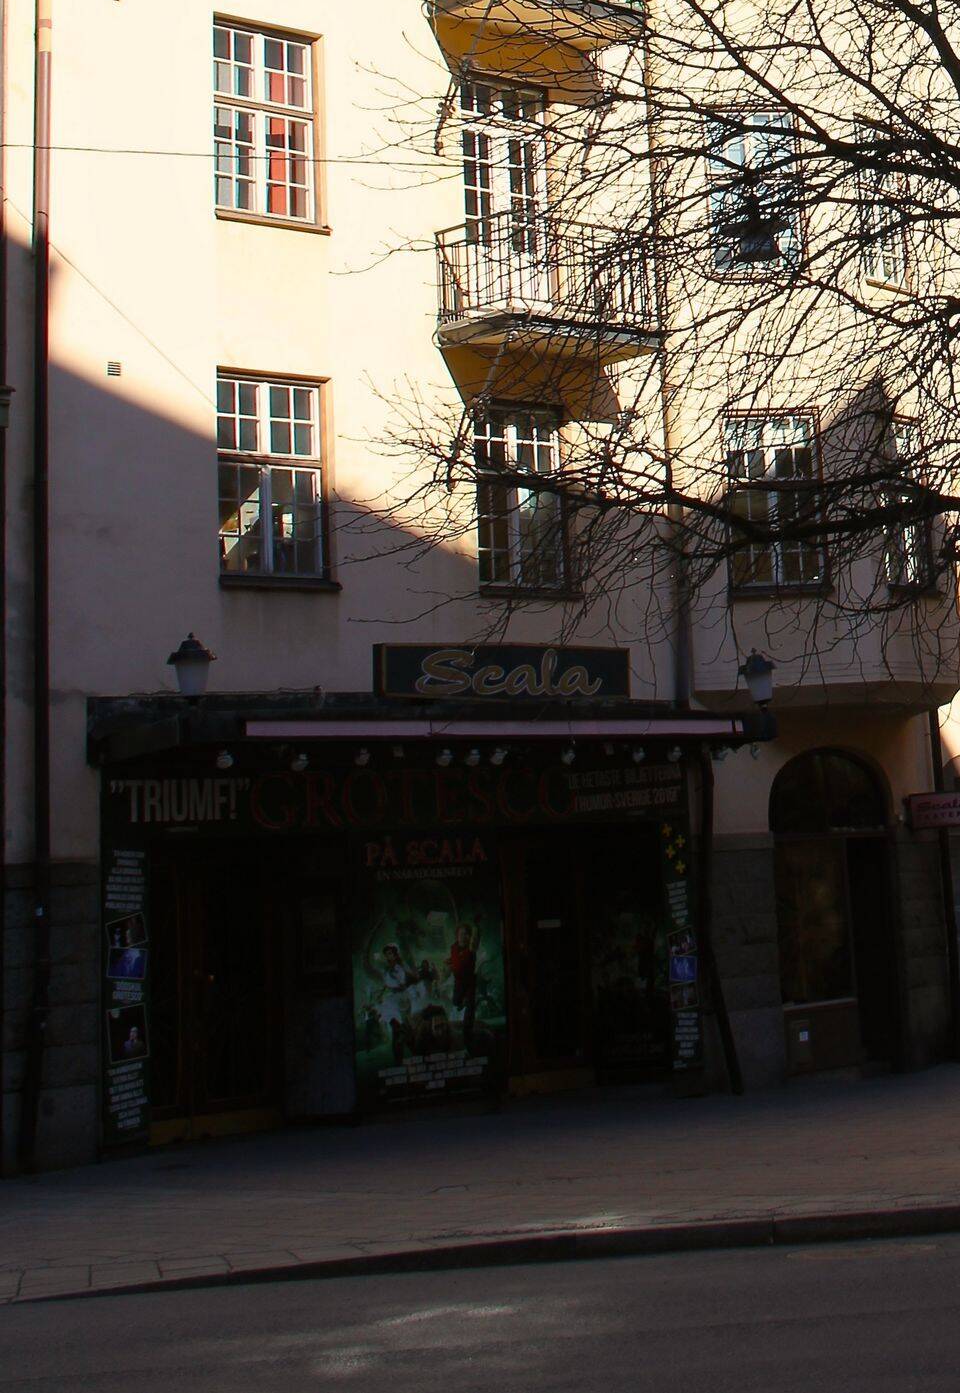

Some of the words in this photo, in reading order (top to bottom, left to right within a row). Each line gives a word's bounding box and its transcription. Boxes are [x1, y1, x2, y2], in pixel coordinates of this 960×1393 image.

[415, 648, 602, 696] Scala
[249, 768, 577, 830] GROTESCO
[404, 836, 487, 865] SCALA
